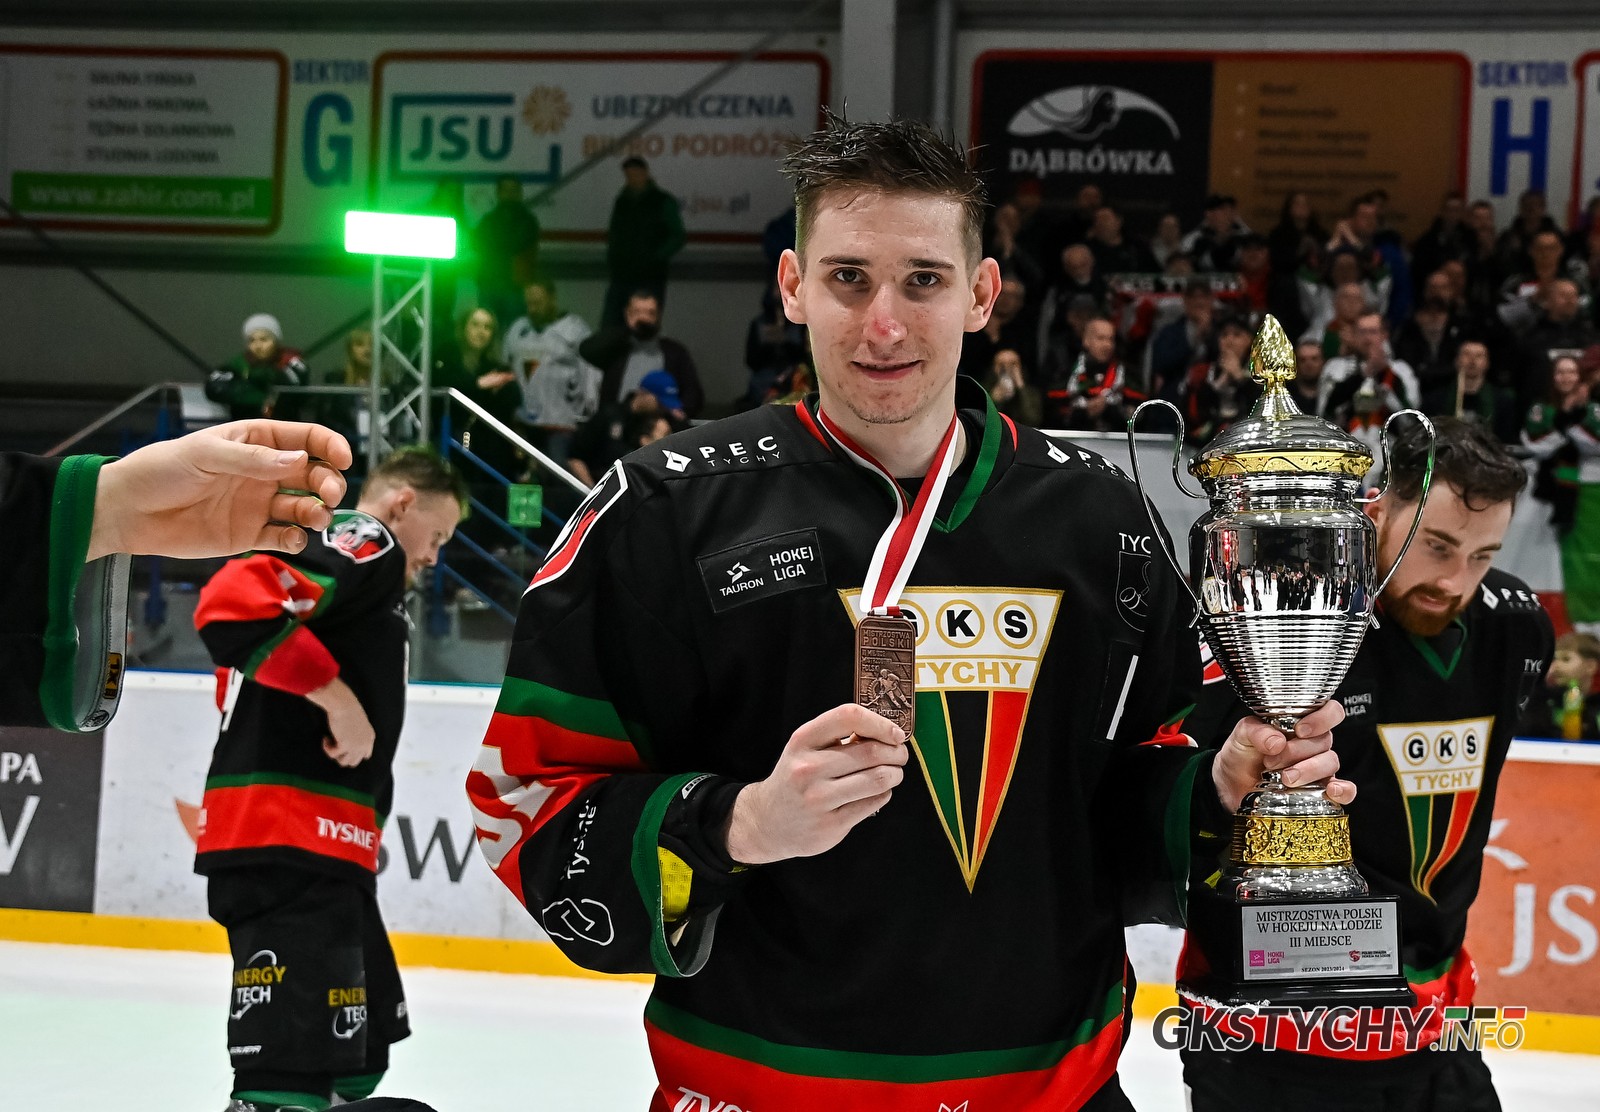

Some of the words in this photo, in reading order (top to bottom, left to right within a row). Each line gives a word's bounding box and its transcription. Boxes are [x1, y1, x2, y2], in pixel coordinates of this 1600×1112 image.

[294, 60, 369, 84] SEKTOR
[1478, 62, 1568, 87] SEKTOR
[592, 94, 794, 118] UBEZPIECZENIA
[304, 92, 353, 187] G
[410, 115, 514, 162] JSU
[1491, 99, 1551, 196] H
[1008, 143, 1175, 179] DĄBRÓWKA
[699, 435, 778, 459] PEC
[707, 451, 782, 467] TYCHY
[769, 546, 814, 566] HOKEJ
[773, 563, 806, 582] LIGA
[719, 578, 764, 597] TAURON
[863, 636, 910, 648] POLSKI
[1408, 734, 1477, 759] GKS
[1414, 771, 1475, 790] TYCHY
[315, 816, 376, 850] TYSKIE
[376, 816, 476, 882] W
[1256, 909, 1340, 922] MISTRZOSTWA
[1343, 907, 1383, 920] POLSKI
[1257, 922, 1270, 934] W
[1272, 920, 1318, 933] HOKEJU
[1321, 920, 1339, 931] NA
[1341, 919, 1383, 931] LODZIE
[1289, 937, 1301, 948] III
[1304, 935, 1352, 948] MIEJSCE
[234, 965, 288, 987] NERGY
[235, 984, 272, 1005] TECH
